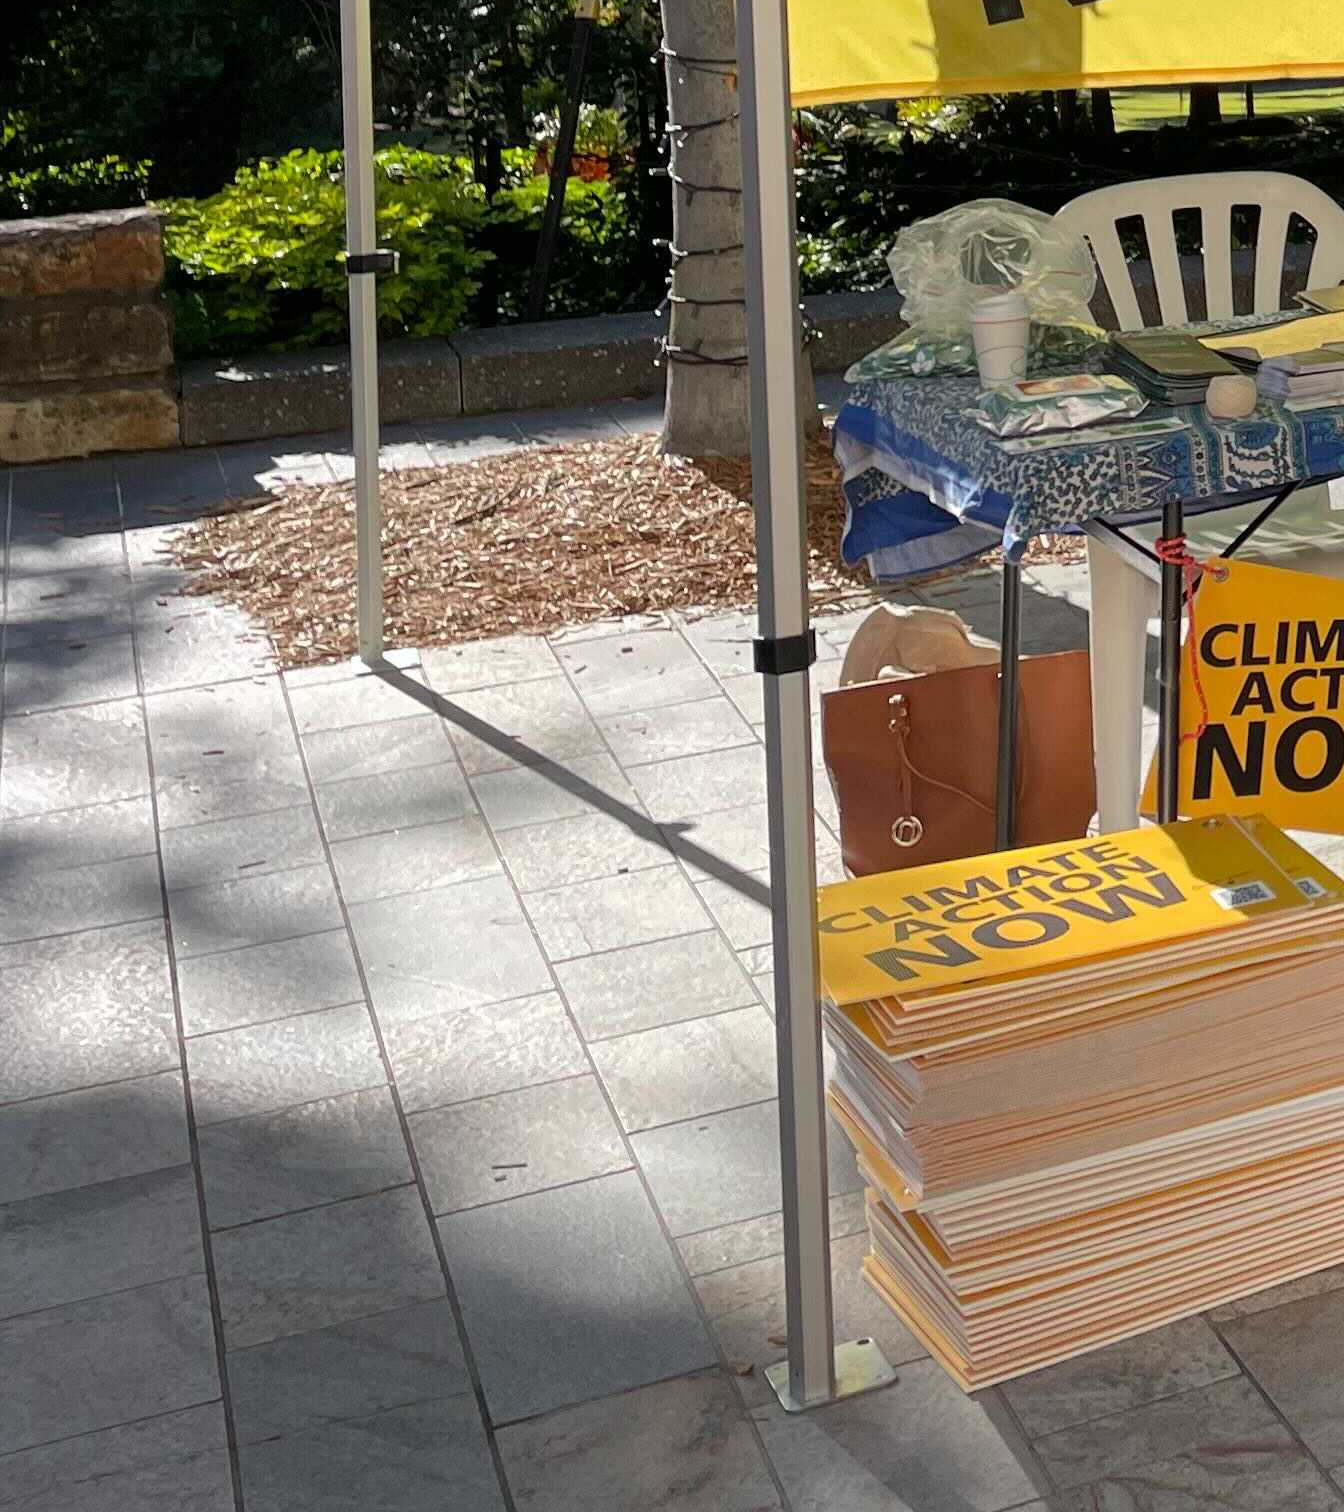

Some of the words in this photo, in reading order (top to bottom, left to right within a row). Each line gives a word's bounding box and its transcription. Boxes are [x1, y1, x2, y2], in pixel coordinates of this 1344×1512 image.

[818, 841, 1125, 936] CLIMATE
[865, 873, 1190, 980] NOW
[889, 855, 1159, 942] ACTION
